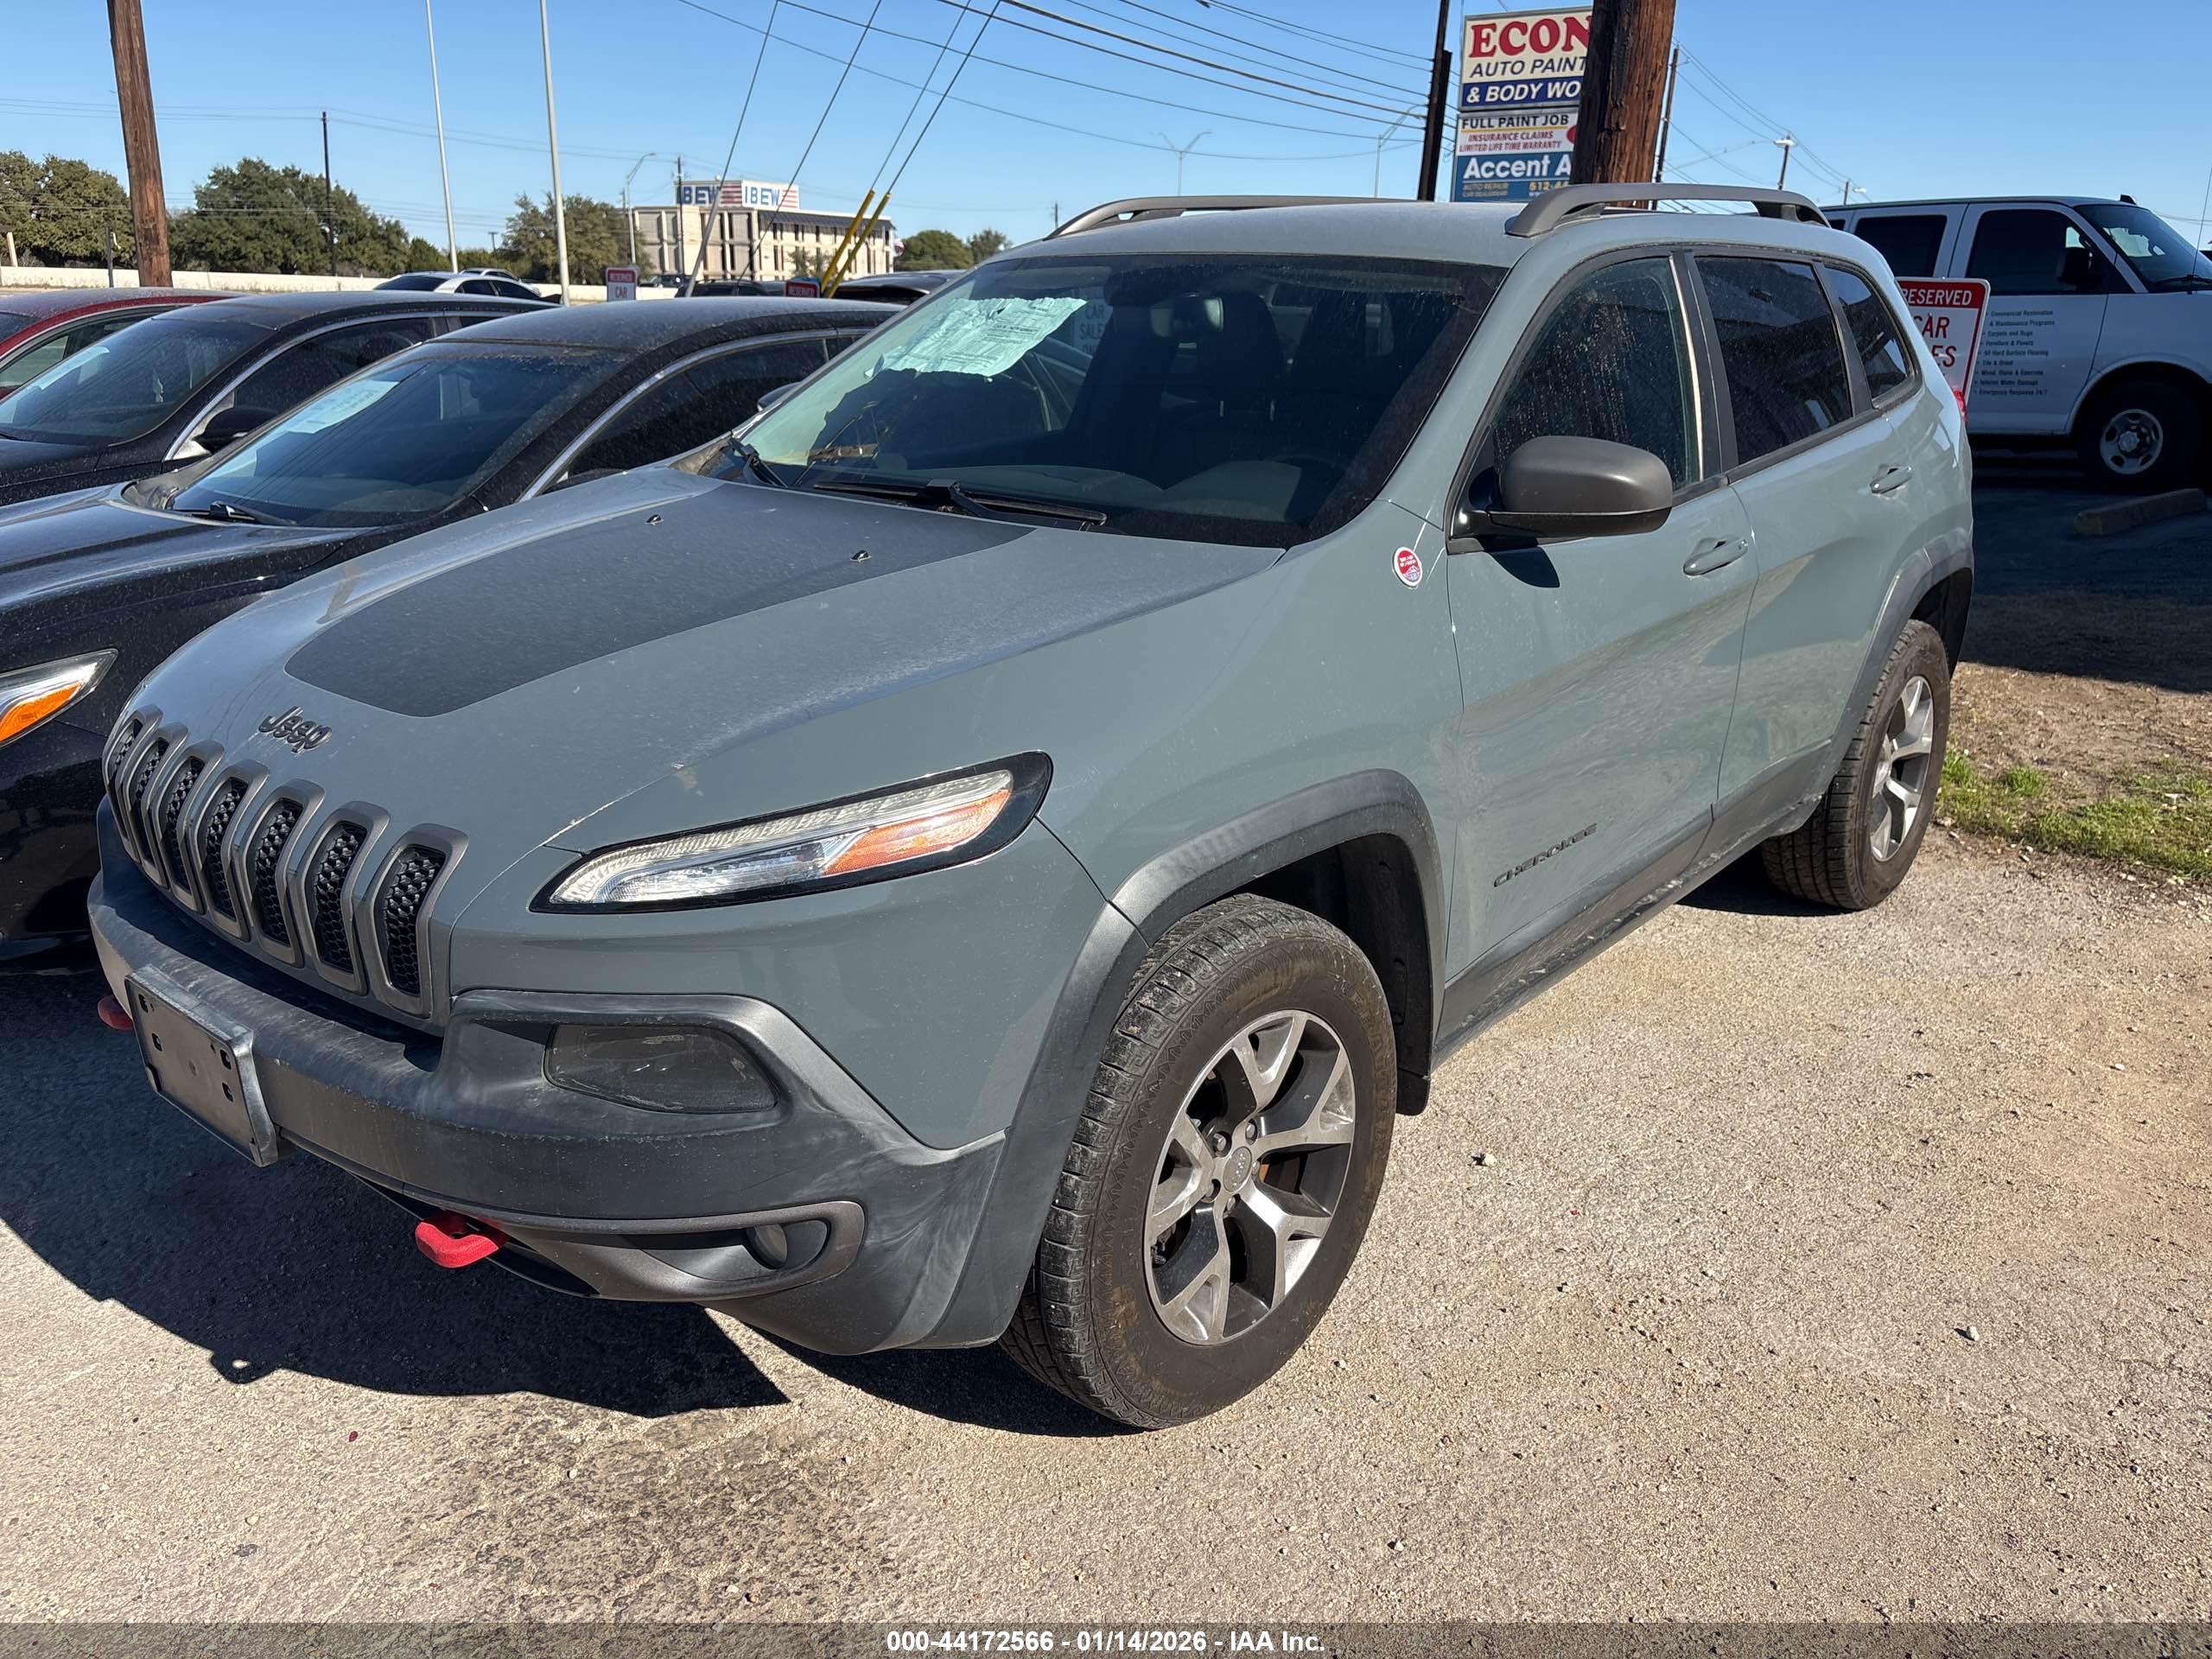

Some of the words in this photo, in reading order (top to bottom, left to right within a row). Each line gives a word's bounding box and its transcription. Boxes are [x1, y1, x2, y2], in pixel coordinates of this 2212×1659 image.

[1469, 16, 1592, 58] ECON
[1470, 60, 1524, 78] AUTO
[1529, 56, 1586, 73] PAINT
[1466, 86, 1480, 103] &
[1484, 83, 1543, 102] BODY
[1547, 80, 1581, 99] WO
[1462, 118, 1495, 129] FULL
[1497, 116, 1539, 128] PAINT
[1541, 114, 1569, 125] JOB
[1468, 133, 1520, 142] INSURANCE
[1520, 130, 1554, 140] CLAIMS
[1463, 155, 1551, 179] Accent
[1554, 154, 1572, 176] A
[745, 186, 780, 207] IBEW
[1079, 323, 1104, 340] SALE
[258, 706, 333, 754] Jeep
